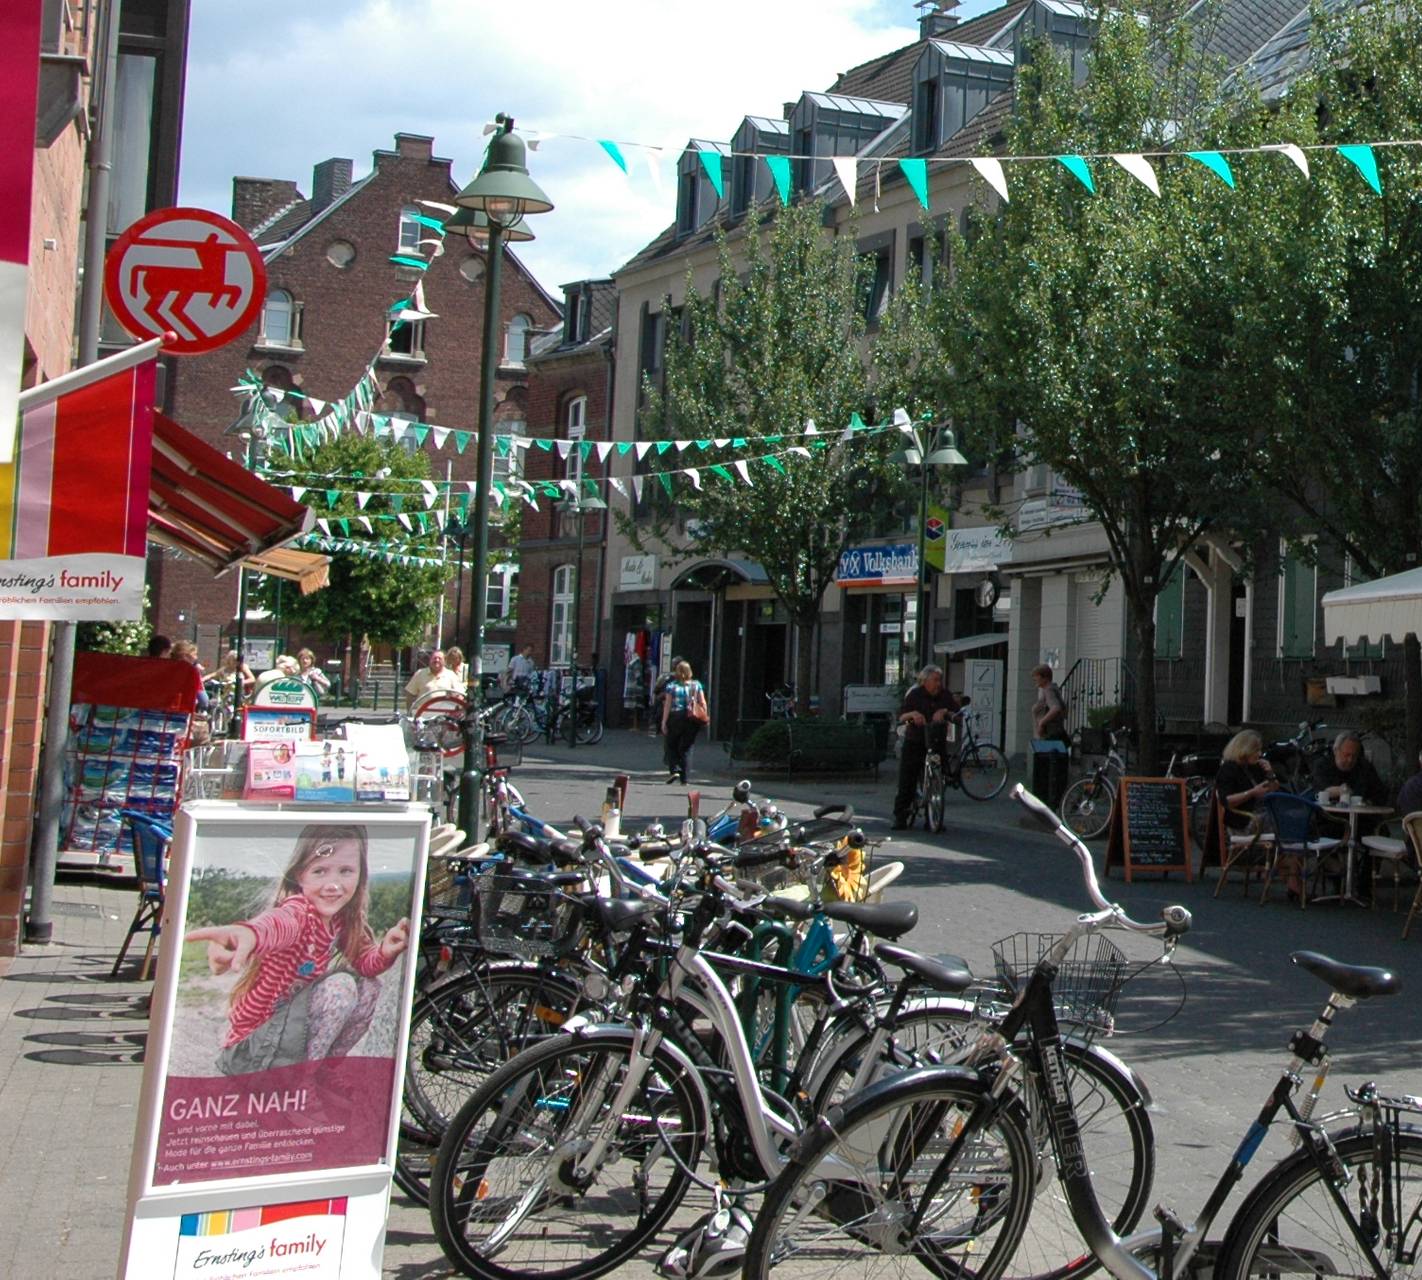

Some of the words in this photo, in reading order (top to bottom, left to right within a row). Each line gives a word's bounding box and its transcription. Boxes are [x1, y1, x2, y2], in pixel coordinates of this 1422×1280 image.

[863, 551, 919, 573] Volksbank
[0, 573, 56, 594] nsting's
[60, 569, 124, 592] family
[253, 725, 305, 734] SOFORTBILD
[1045, 1044, 1068, 1105] KETTLER
[170, 1094, 240, 1121] GANZ
[247, 1089, 307, 1115] NAH!
[166, 1137, 188, 1148] Jetzt
[190, 1133, 240, 1145] reinschauen
[241, 1131, 257, 1140] und
[258, 1126, 312, 1139] überraschend
[313, 1124, 345, 1136] günstige
[177, 1126, 193, 1134] und
[195, 1124, 218, 1133] vorne
[220, 1122, 234, 1130] mit
[165, 1148, 188, 1158] Mode
[189, 1146, 202, 1156] für
[204, 1145, 217, 1154] die
[218, 1144, 243, 1155] ganze
[163, 1163, 185, 1173] Auch
[186, 1161, 209, 1170] unter
[193, 1245, 265, 1269] Ernsting's
[270, 1233, 327, 1257] family
